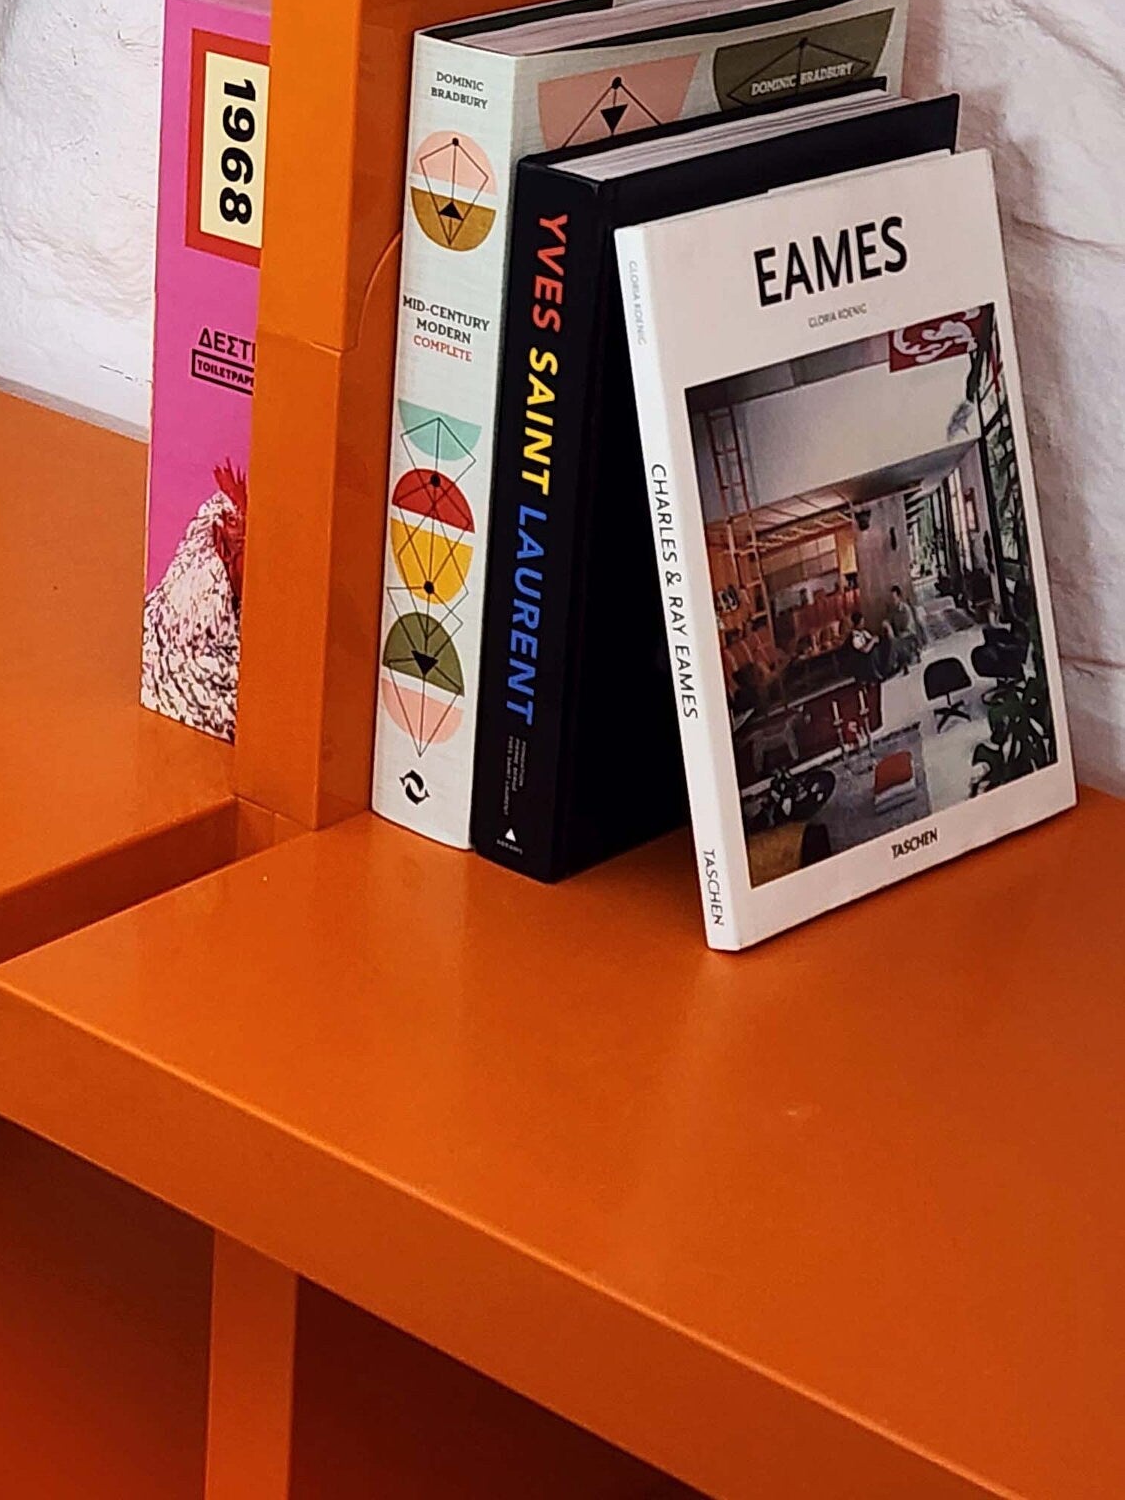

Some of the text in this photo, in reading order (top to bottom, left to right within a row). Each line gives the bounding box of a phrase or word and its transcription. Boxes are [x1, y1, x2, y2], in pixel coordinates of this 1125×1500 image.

[436, 71, 484, 92] DOMINIC
[751, 62, 854, 96] DOMINIC BRADBURY
[431, 87, 488, 110] BRADBURY
[219, 78, 257, 225] 1968
[753, 216, 908, 308] EAMES
[402, 294, 490, 332] MID-CENTURY
[808, 303, 868, 329] GLORIA KOENIG
[416, 317, 472, 345] MODERN
[413, 335, 473, 363] COMPLETE
[505, 213, 569, 726] YVES SAINT LAURENT
[651, 463, 699, 720] CHARLES & RAY EAMES
[890, 828, 938, 859] TASCHEN
[703, 849, 725, 926] TASCHEN
